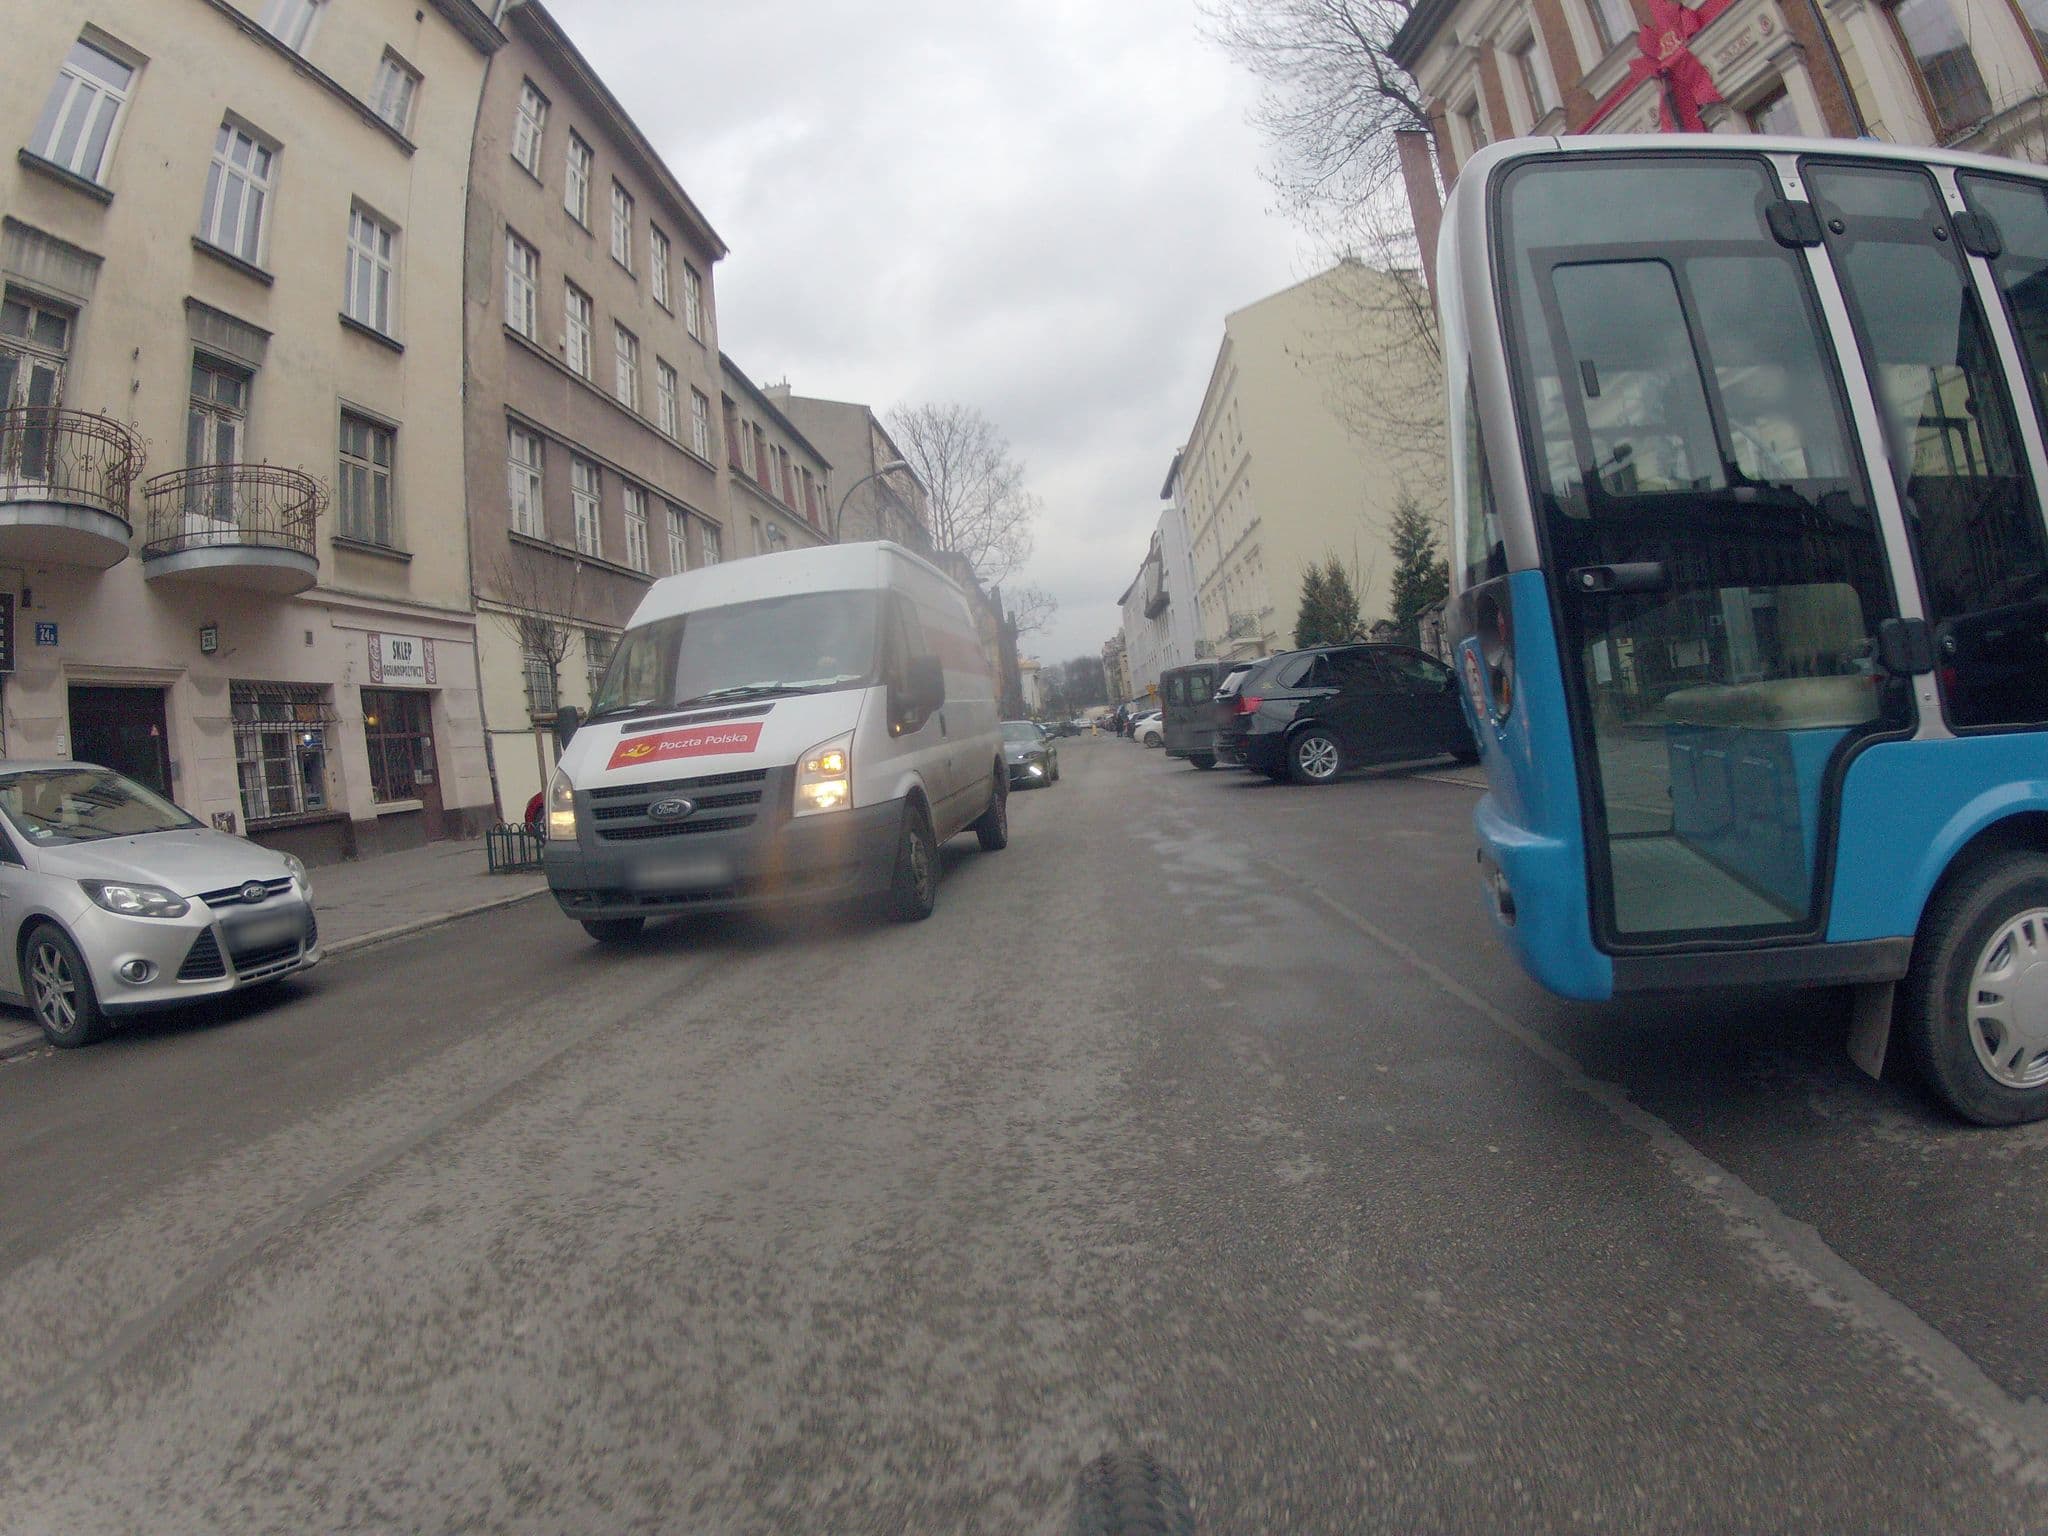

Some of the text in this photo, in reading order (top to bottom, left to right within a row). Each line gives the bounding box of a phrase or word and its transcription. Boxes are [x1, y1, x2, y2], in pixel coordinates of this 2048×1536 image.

[392, 640, 412, 660] SKLEP
[658, 733, 748, 750] Poczta Polska
[656, 802, 680, 815] Ford
